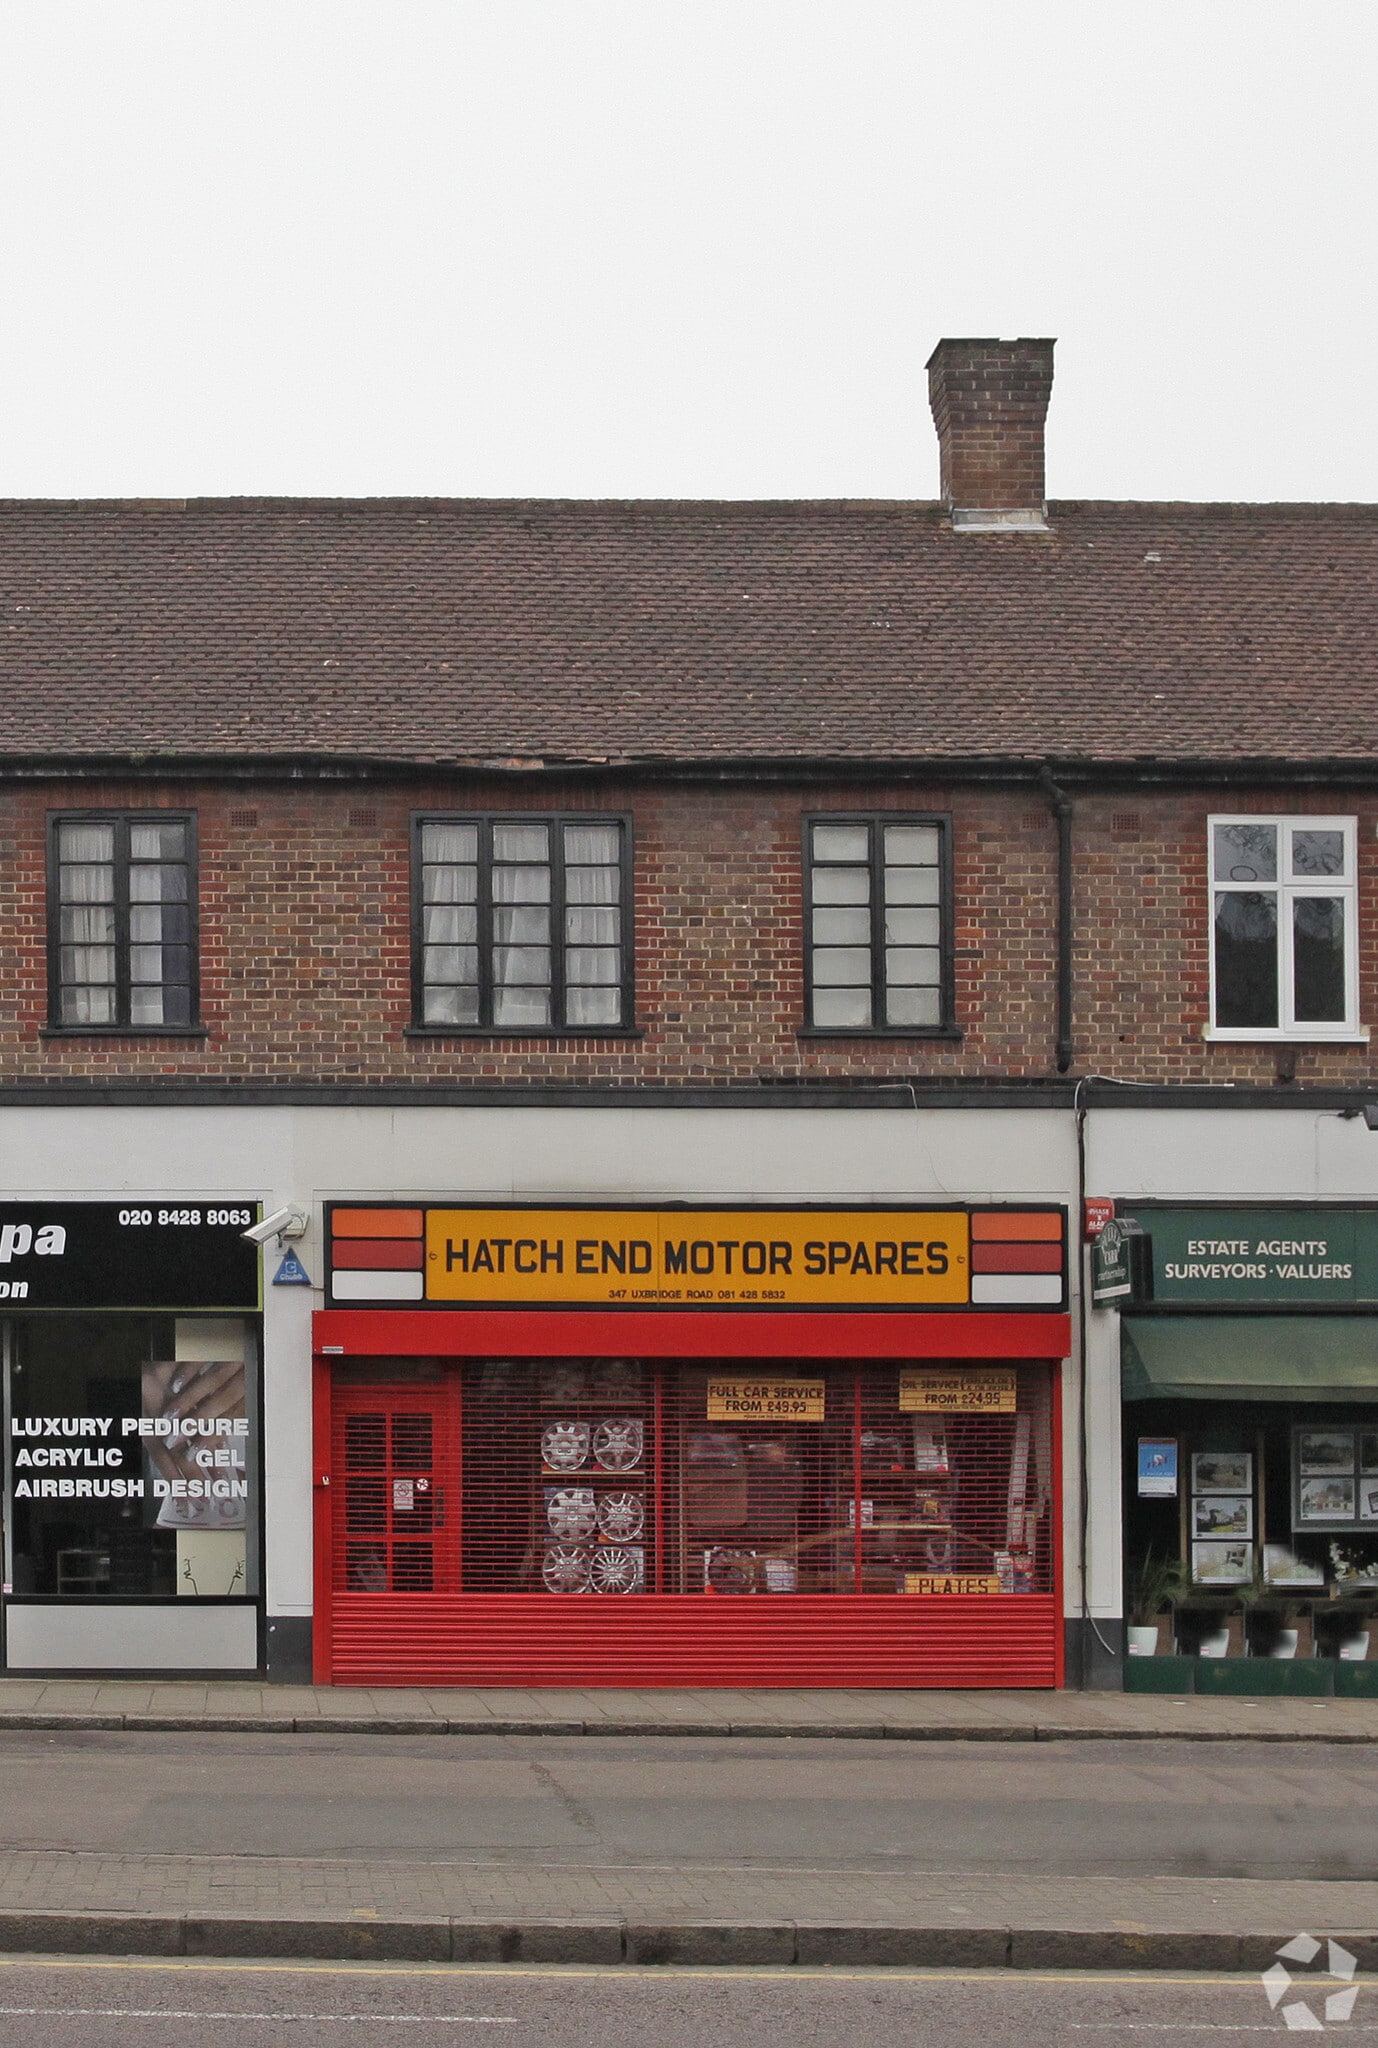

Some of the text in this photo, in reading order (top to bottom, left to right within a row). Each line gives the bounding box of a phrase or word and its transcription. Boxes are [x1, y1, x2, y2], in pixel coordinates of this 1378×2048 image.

[117, 1209, 252, 1226] 020 8428 8063
[0, 1224, 67, 1263] pa
[1187, 1240, 1328, 1256] ESTATE AGENTS
[445, 1238, 949, 1276] HATCH END MOTOR SPARES
[1164, 1263, 1352, 1279] SURVEYORS VALUERS
[608, 1289, 786, 1299] 347 UXBRIDGE ROAD 081 428 5832
[709, 1385, 824, 1399] FULL CAR SERVICE
[924, 1393, 958, 1404] FROM
[725, 1400, 762, 1412] FROM
[11, 1418, 250, 1437] LUXURY PEDICURE
[15, 1448, 246, 1467] ACRYLIC GEL
[14, 1479, 249, 1498] AIRBRUSH DESIGN
[919, 1578, 989, 1594] PLATES
